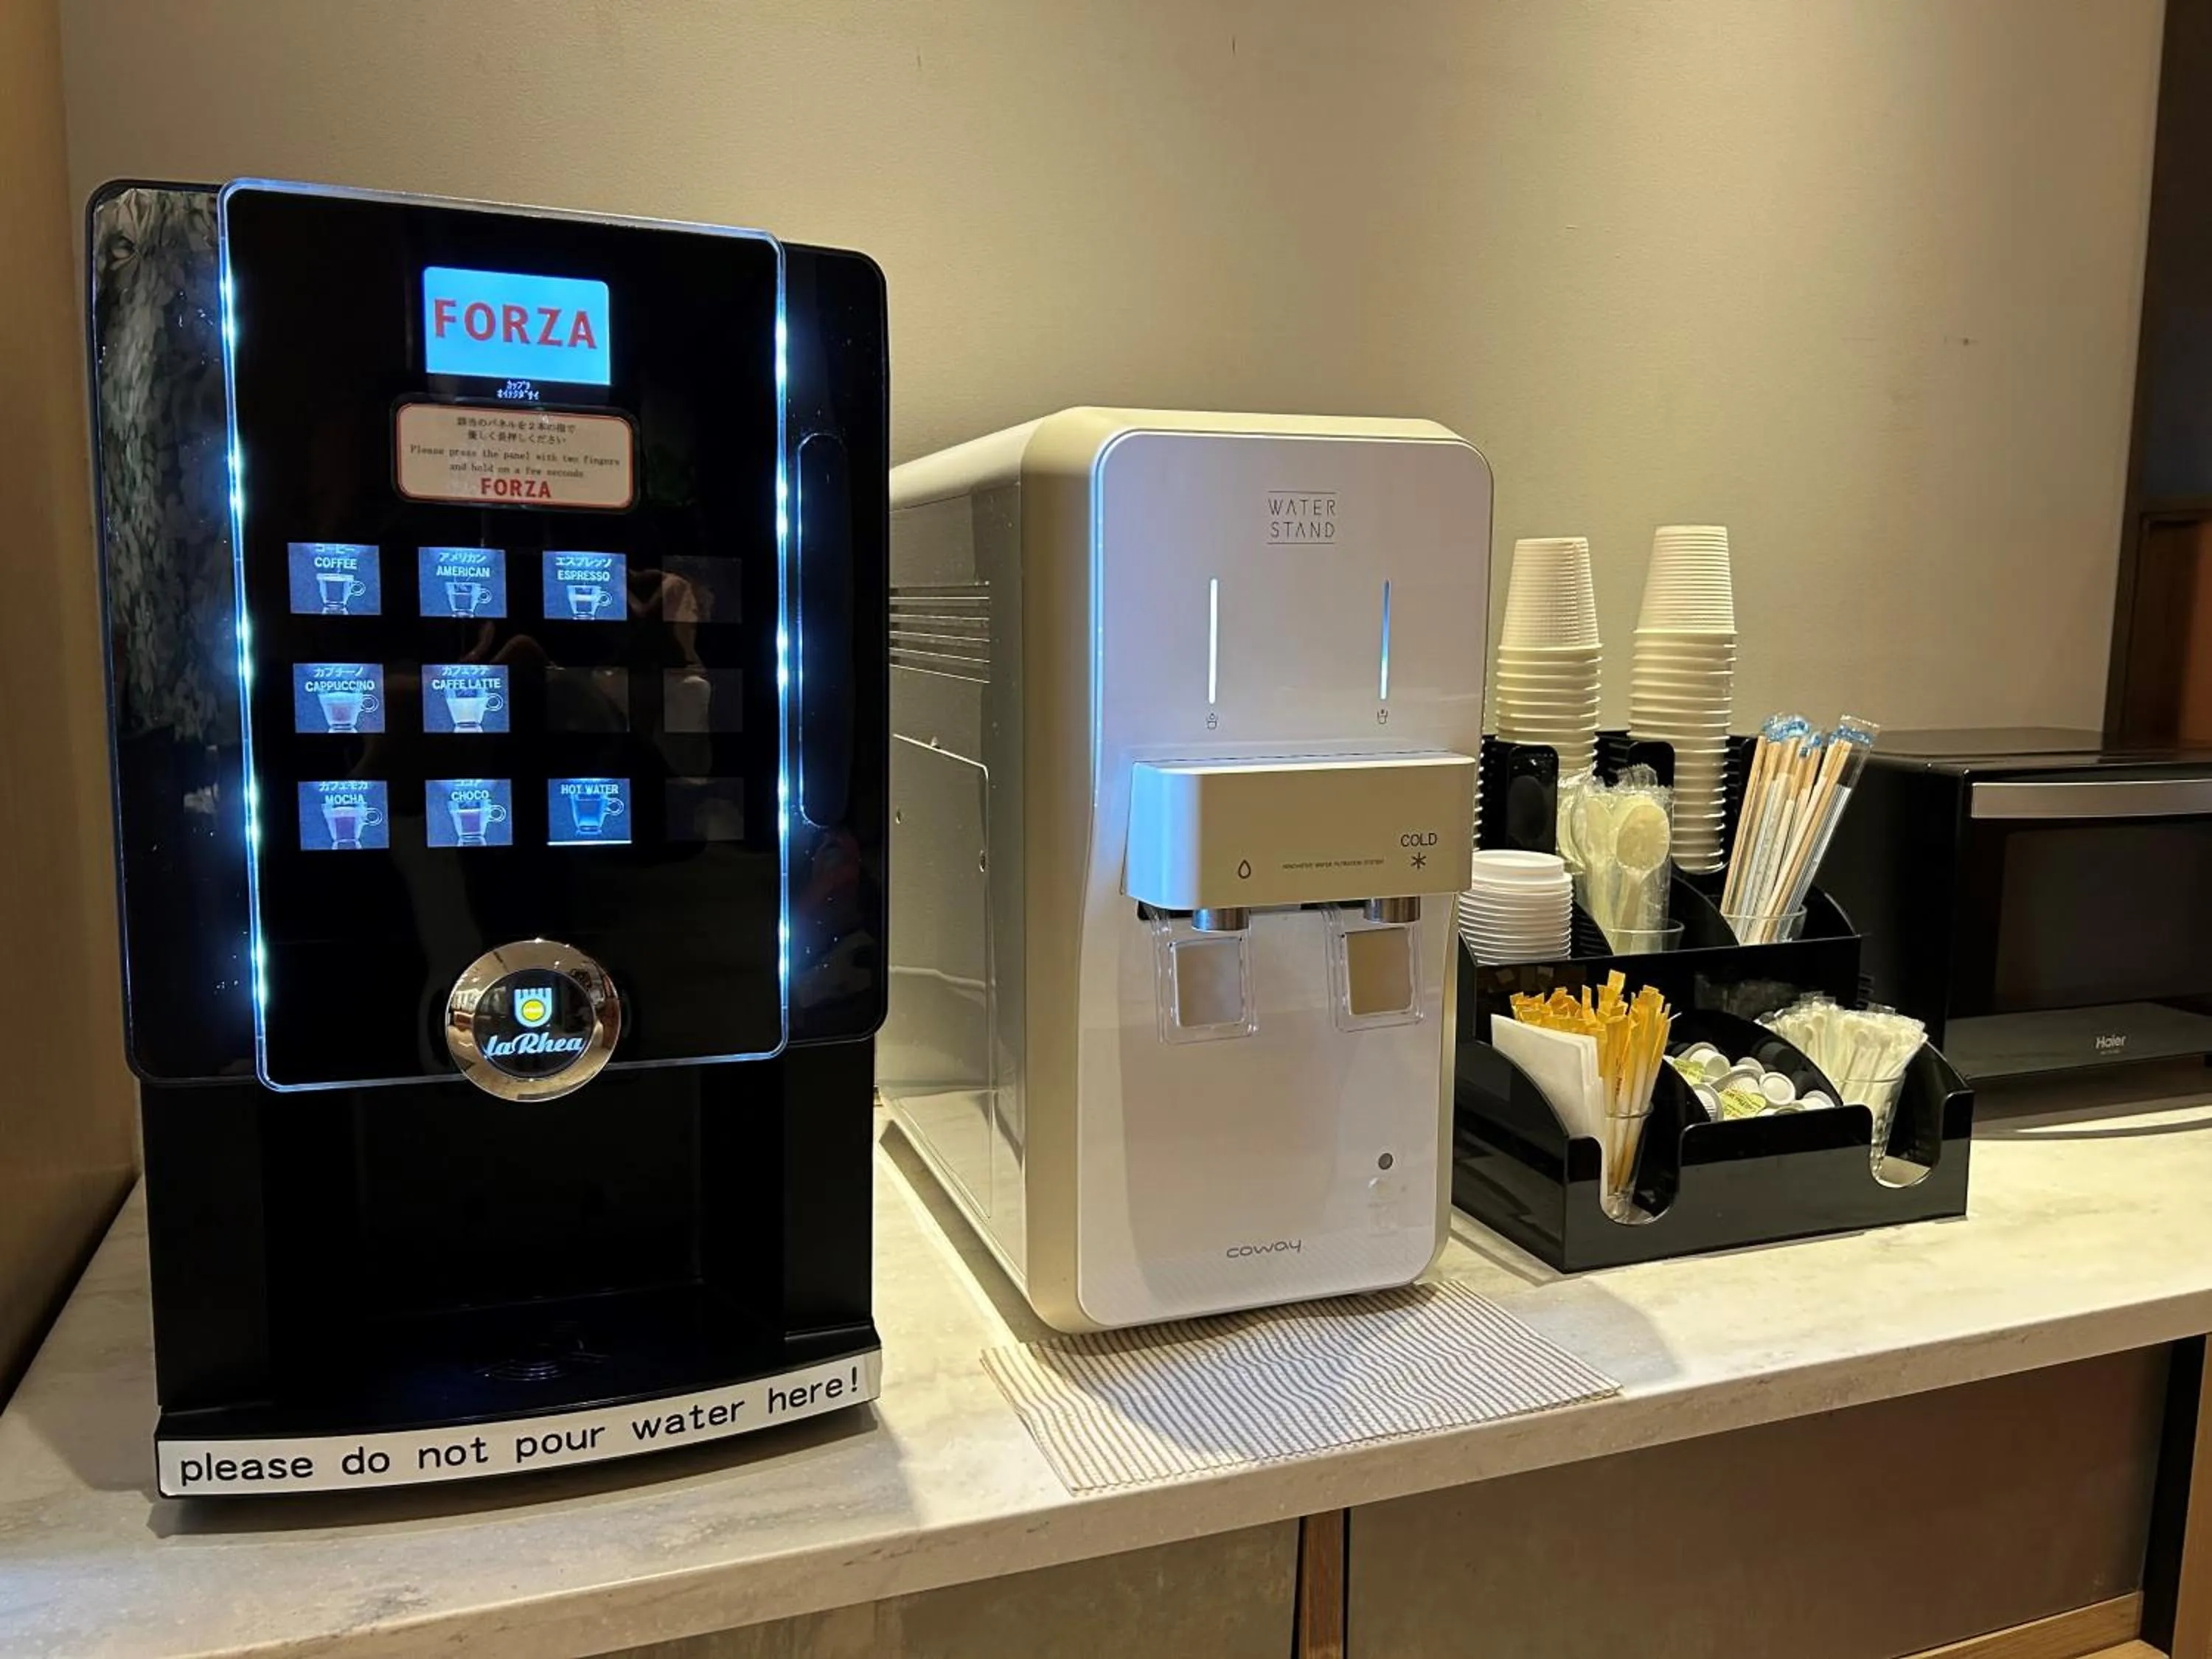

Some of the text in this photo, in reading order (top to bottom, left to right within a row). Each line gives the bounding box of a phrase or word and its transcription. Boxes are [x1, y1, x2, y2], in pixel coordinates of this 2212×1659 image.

[434, 298, 597, 349] FORZA
[411, 444, 620, 466] Please press the panel with two fingers
[450, 463, 467, 471] and
[471, 463, 493, 473] hold
[525, 467, 541, 475] few
[546, 469, 584, 478] seconds
[481, 478, 552, 499] FORZA
[1267, 498, 1336, 516] WATER
[1270, 521, 1335, 538] STAND
[314, 557, 358, 570] COFFEE
[436, 566, 490, 578] AMERICAN
[557, 570, 611, 582] ESPRESSO
[305, 680, 375, 692] CAPPUCCINO
[431, 678, 502, 690] CAFFE LATTE
[451, 790, 489, 802] CHOCO
[560, 784, 619, 795] HOT WATER
[324, 793, 366, 804] MOCHA
[1400, 832, 1437, 847] COLD
[2096, 1034, 2126, 1049] Haier
[1226, 1239, 1301, 1258] coway
[181, 1366, 858, 1486] please do not pour water here!
